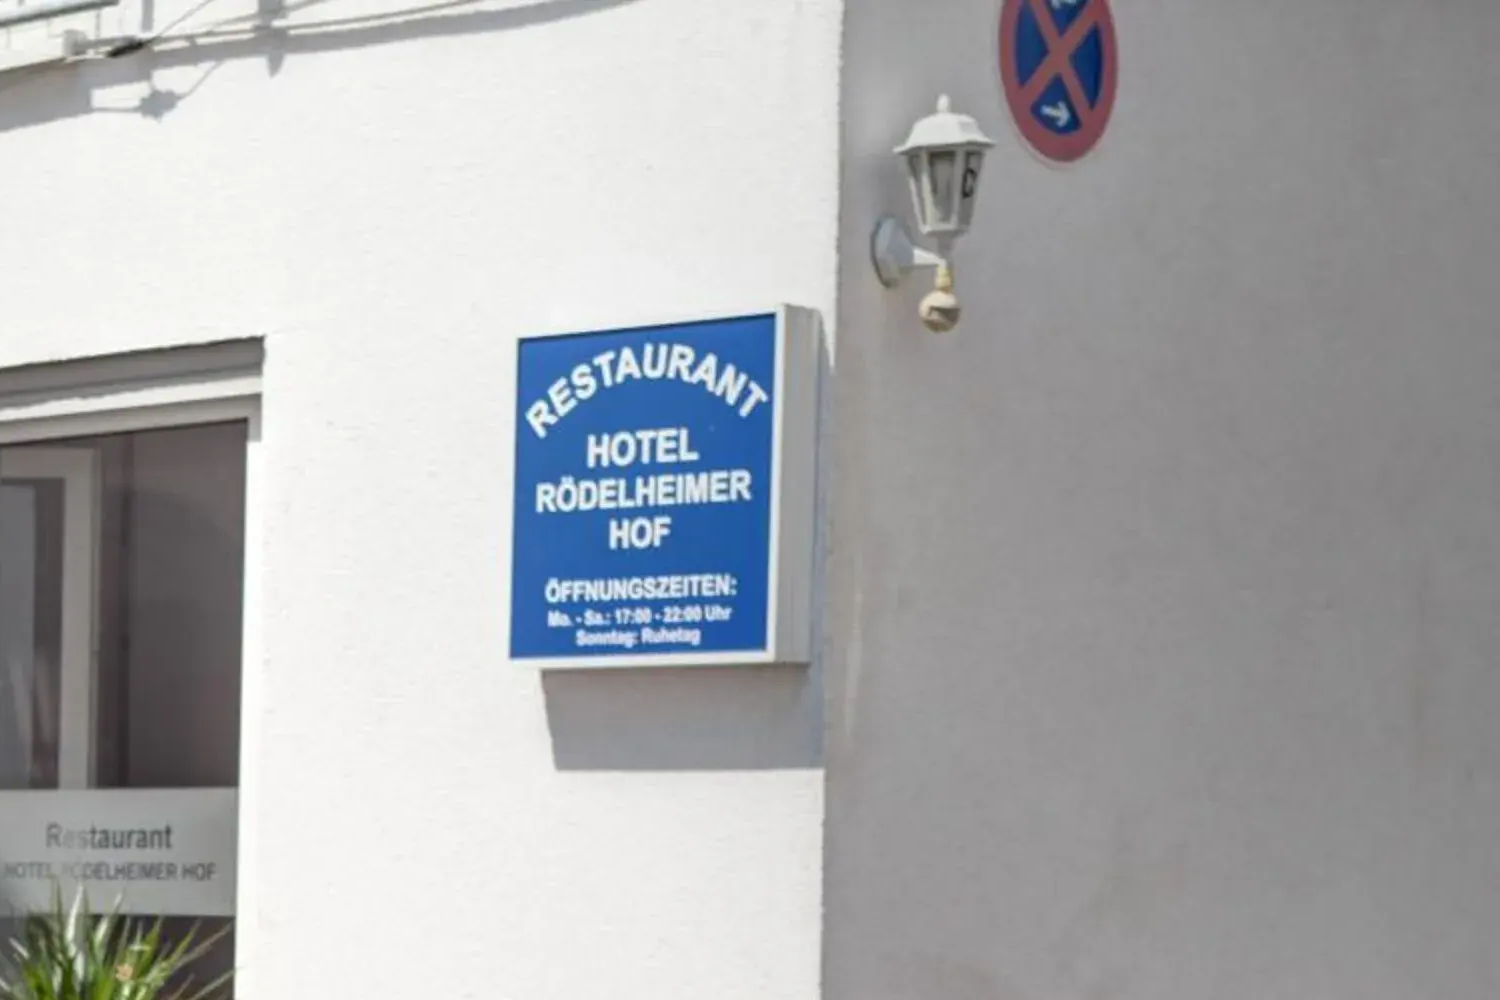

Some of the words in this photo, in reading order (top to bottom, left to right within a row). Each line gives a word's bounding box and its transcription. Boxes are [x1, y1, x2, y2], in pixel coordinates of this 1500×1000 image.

[525, 342, 768, 438] RESTAURANT
[587, 428, 698, 468] HOTEL
[535, 469, 751, 512] RÖDELHEIMER
[609, 516, 671, 549] HOF
[545, 573, 737, 603] ÖFFNUNGSZEITEN:
[548, 611, 573, 627] Mo.
[704, 604, 732, 621] Uhr
[641, 627, 701, 646] Ruhetag
[46, 822, 173, 849] Restaurant
[3, 861, 56, 880] HOTEL
[182, 861, 218, 881] HOF
